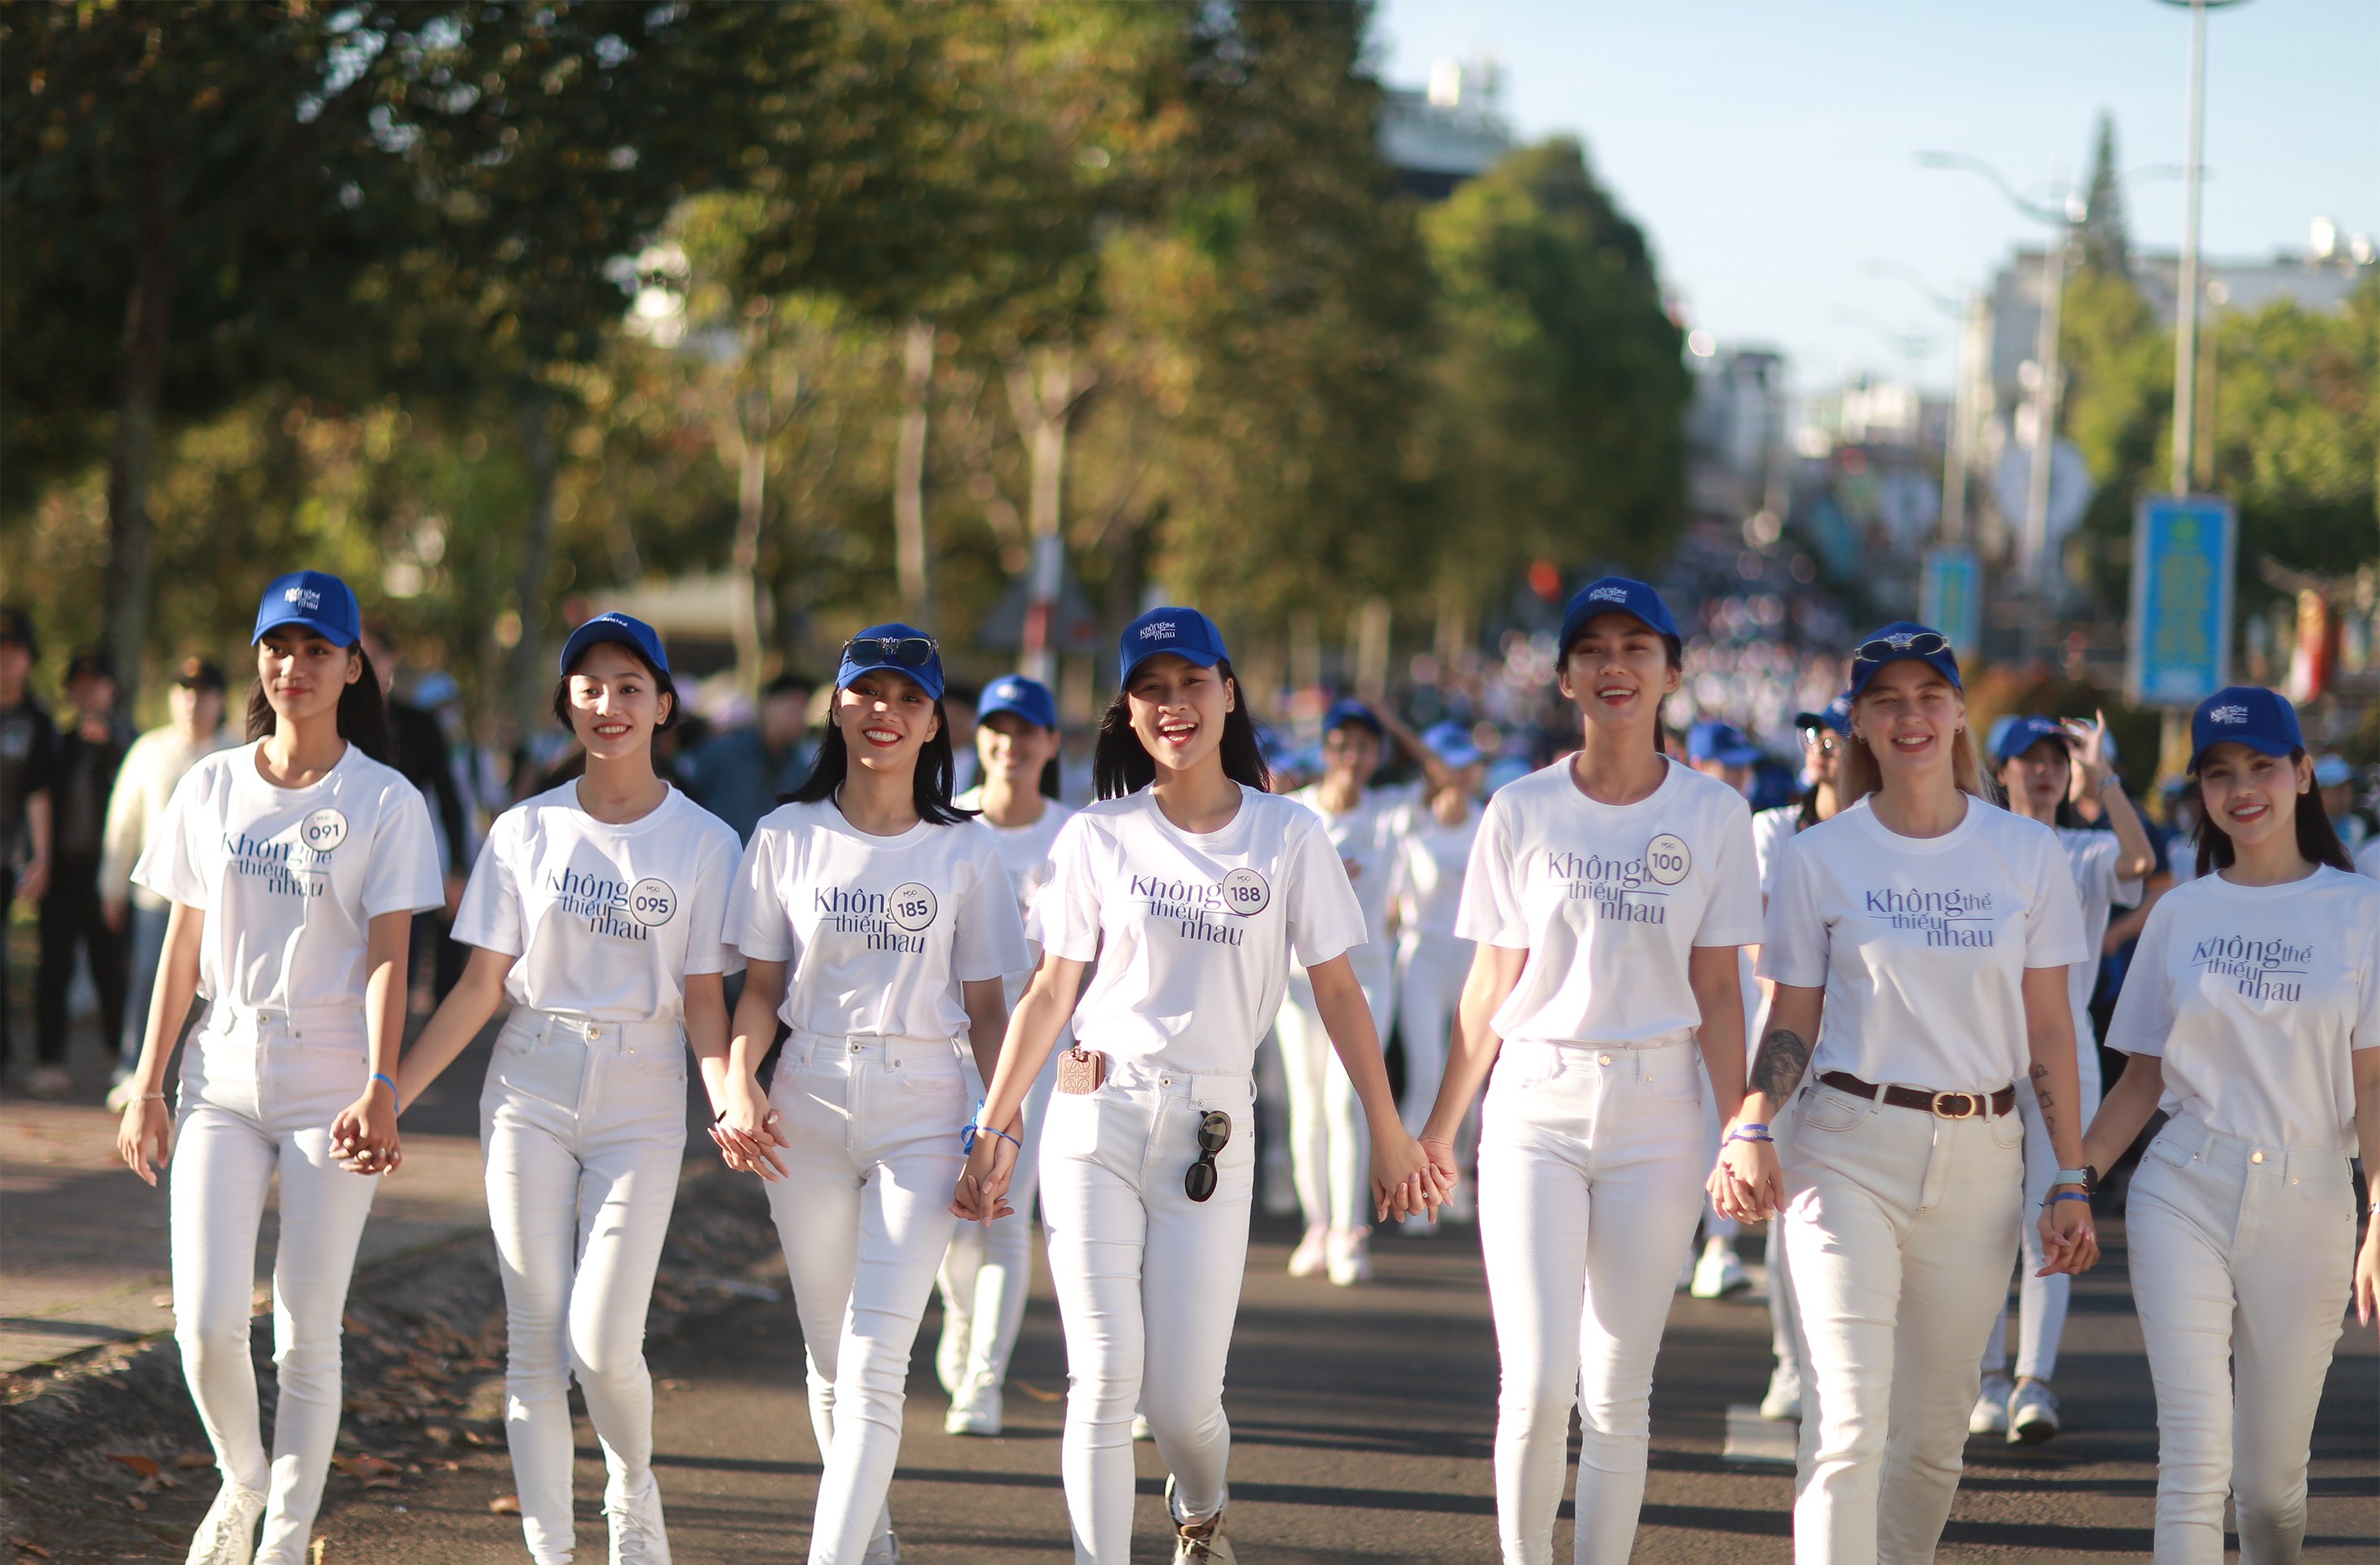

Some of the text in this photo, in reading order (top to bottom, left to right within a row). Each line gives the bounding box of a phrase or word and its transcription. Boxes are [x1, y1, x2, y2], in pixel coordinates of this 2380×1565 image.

[310, 824, 339, 840] 091
[1548, 852, 1641, 889] Không
[1652, 853, 1682, 871] 100
[269, 869, 324, 897] nhau
[545, 867, 629, 907] Không
[1130, 875, 1223, 910] Không
[1231, 886, 1261, 902] 188
[1569, 880, 1618, 902] thiếu
[562, 895, 606, 917] thiếu
[636, 896, 668, 914] 095
[814, 886, 894, 920] Khôn
[897, 900, 928, 919] 185
[1150, 899, 1200, 921] thiếu
[1601, 889, 1665, 924] nhau
[1866, 888, 1993, 918] Không thể
[590, 906, 647, 941] nhau
[835, 913, 883, 933] thiếu
[1181, 910, 1245, 946] nhau
[1892, 912, 1942, 930] thiếu
[1927, 919, 1994, 948] nhau
[867, 922, 925, 954] nhau
[2192, 934, 2313, 969] Không thể
[2208, 958, 2258, 981] thiếu
[2239, 970, 2302, 1003] nhau
